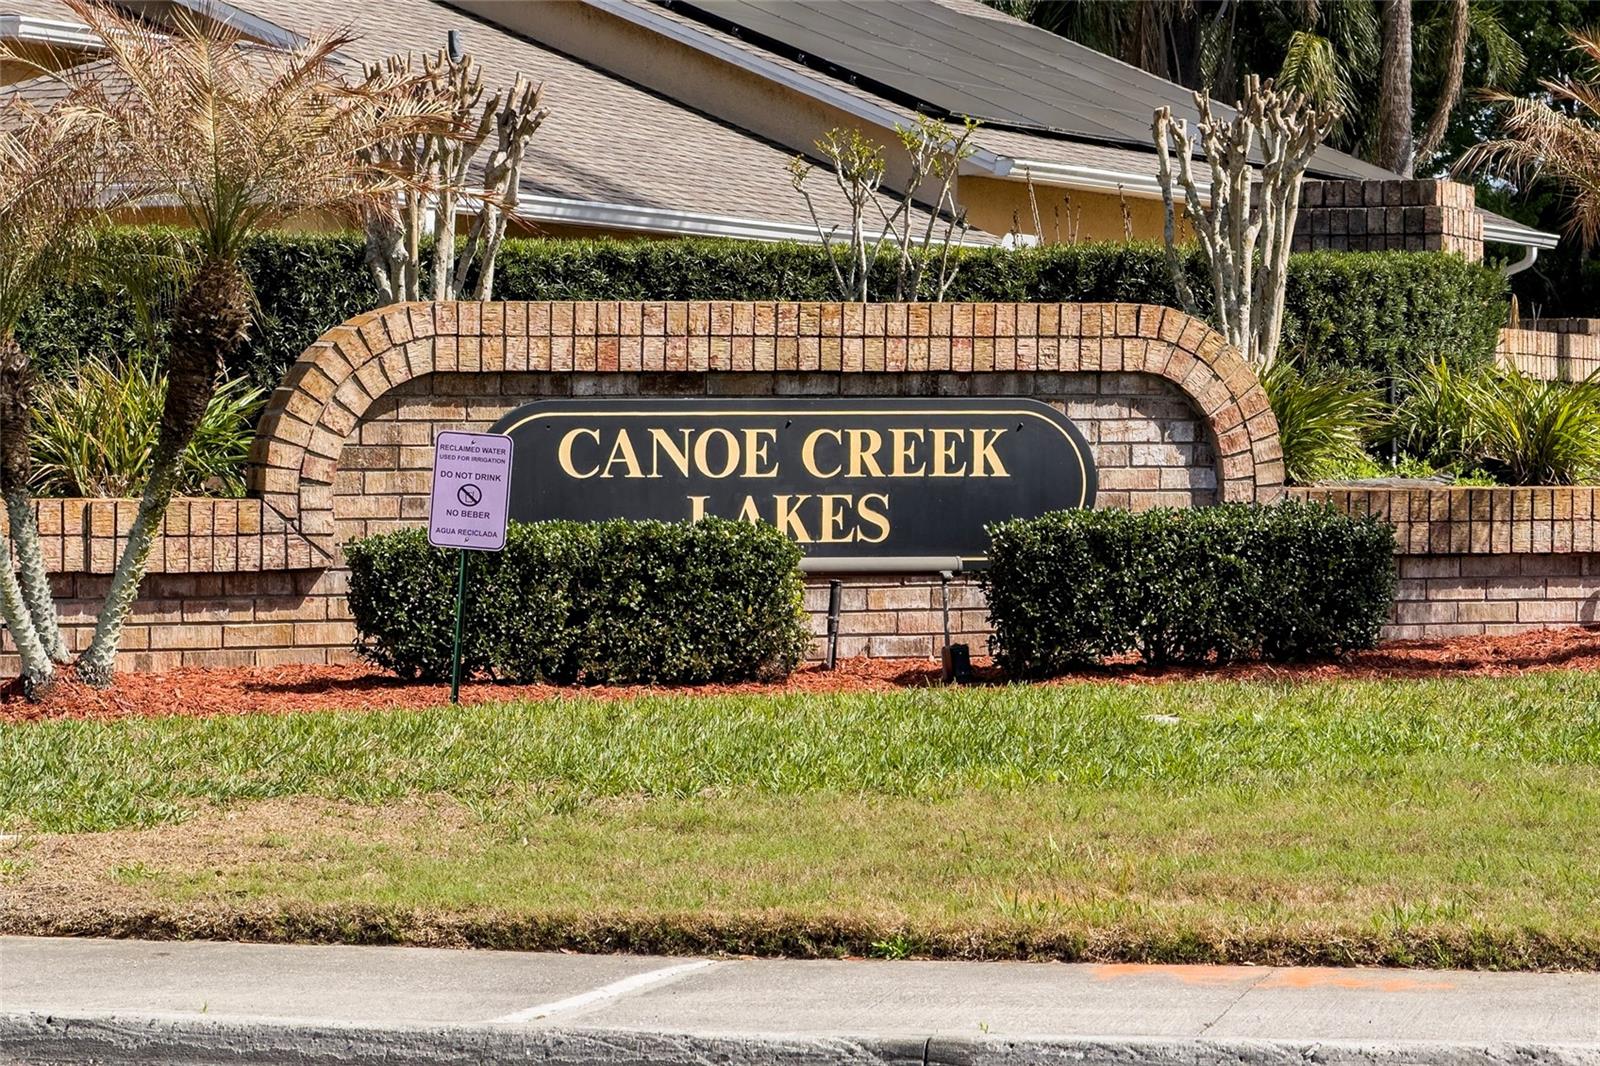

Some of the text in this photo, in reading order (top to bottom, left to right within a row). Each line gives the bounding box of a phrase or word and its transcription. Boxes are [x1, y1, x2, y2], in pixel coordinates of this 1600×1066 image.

[440, 444, 480, 453] RECLAIMED
[558, 428, 1010, 479] CANOE CREEK
[440, 470, 502, 482] DO NOT DRINK
[460, 510, 490, 519] BEBER
[458, 528, 498, 538] RECICLADA
